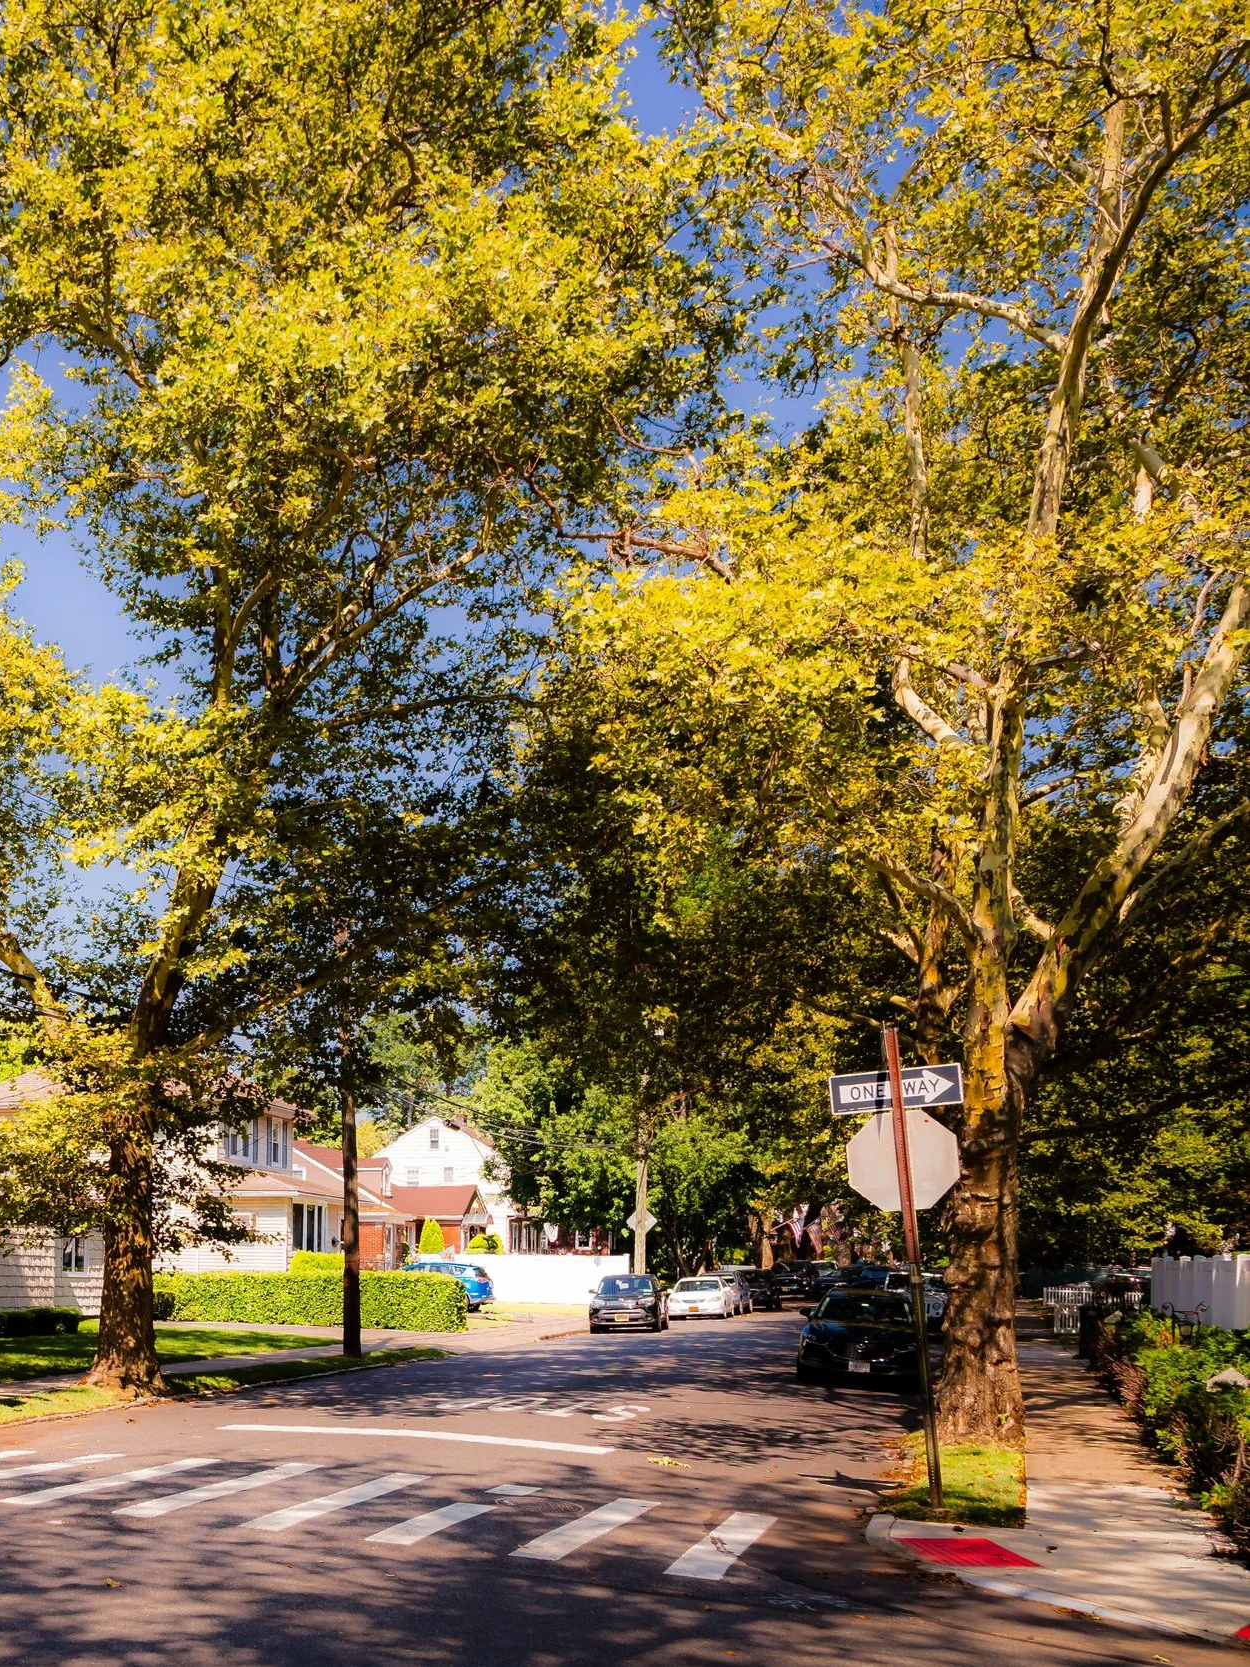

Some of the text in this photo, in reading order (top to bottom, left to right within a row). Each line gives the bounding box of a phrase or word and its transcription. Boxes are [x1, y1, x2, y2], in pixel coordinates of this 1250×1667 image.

[850, 1078, 940, 1100] ONE WAY
[436, 1396, 650, 1423] STOP
